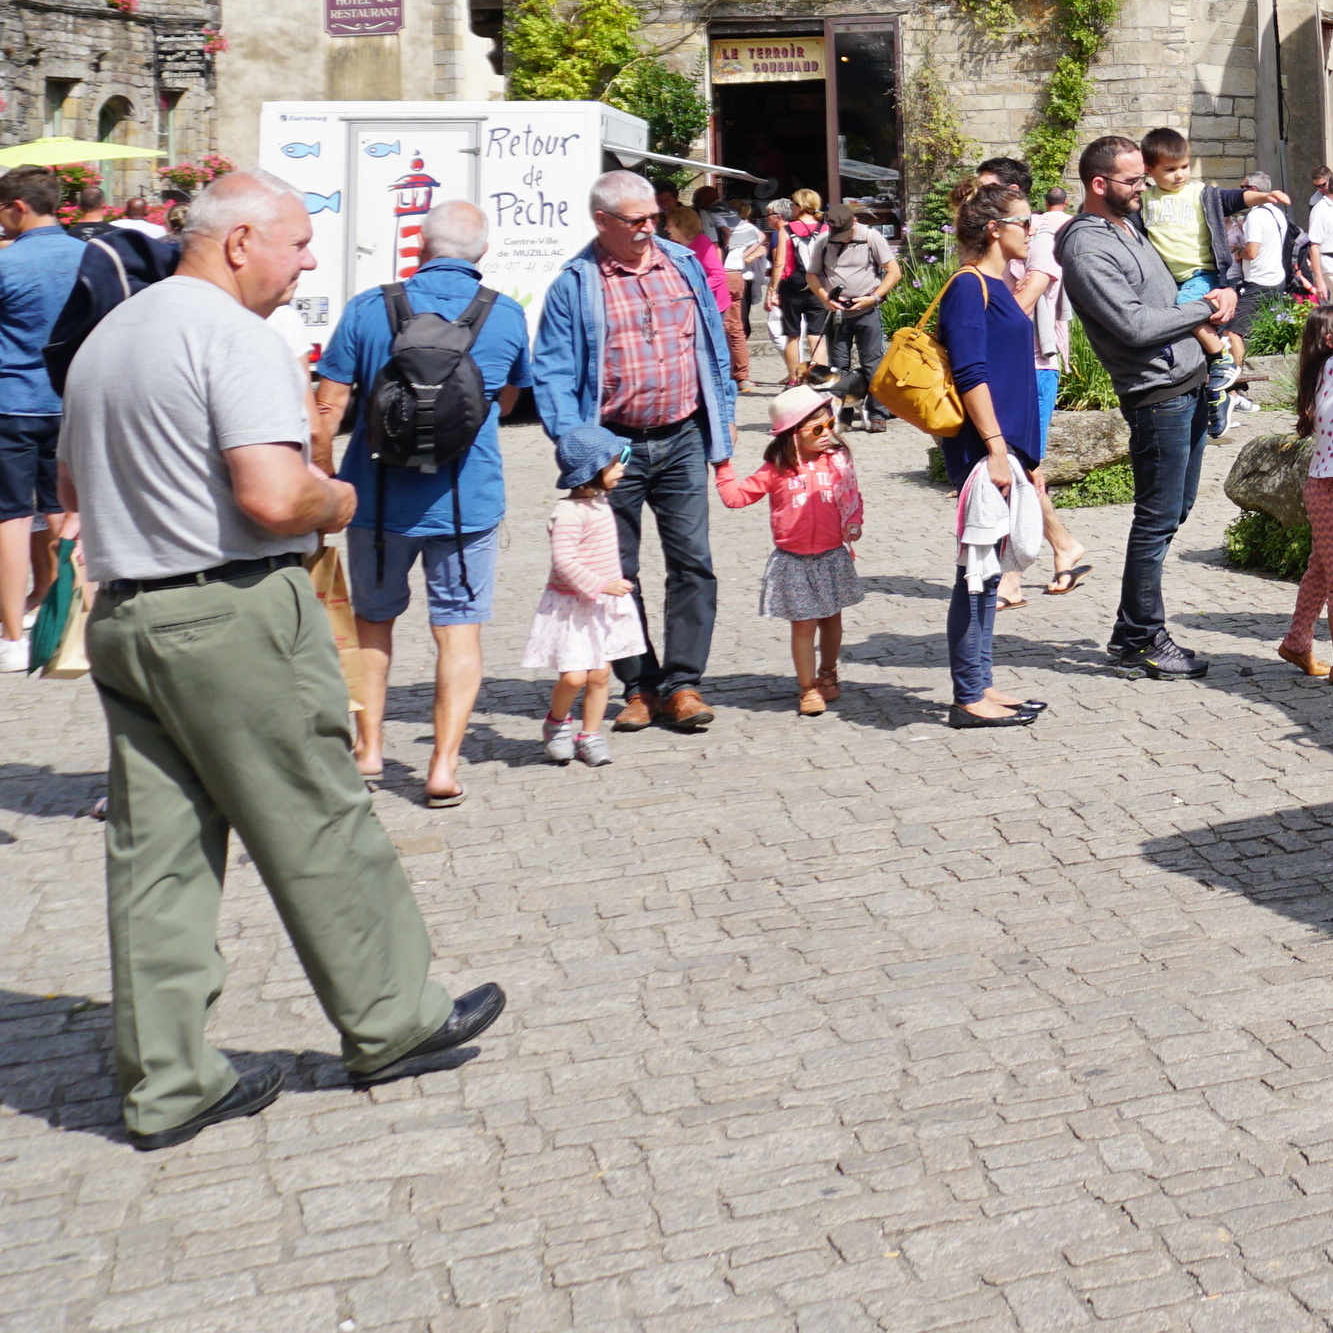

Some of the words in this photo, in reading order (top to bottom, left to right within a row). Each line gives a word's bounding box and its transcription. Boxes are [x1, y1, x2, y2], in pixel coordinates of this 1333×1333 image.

[330, 7, 399, 19] RESTAURANT
[722, 48, 739, 60] LE
[753, 61, 819, 73] GOURMAND
[486, 123, 580, 159] Retour
[522, 164, 543, 189] de
[489, 190, 569, 228] Pêche
[503, 237, 559, 246] Centre-Ville
[513, 248, 565, 257] MUZILLAC
